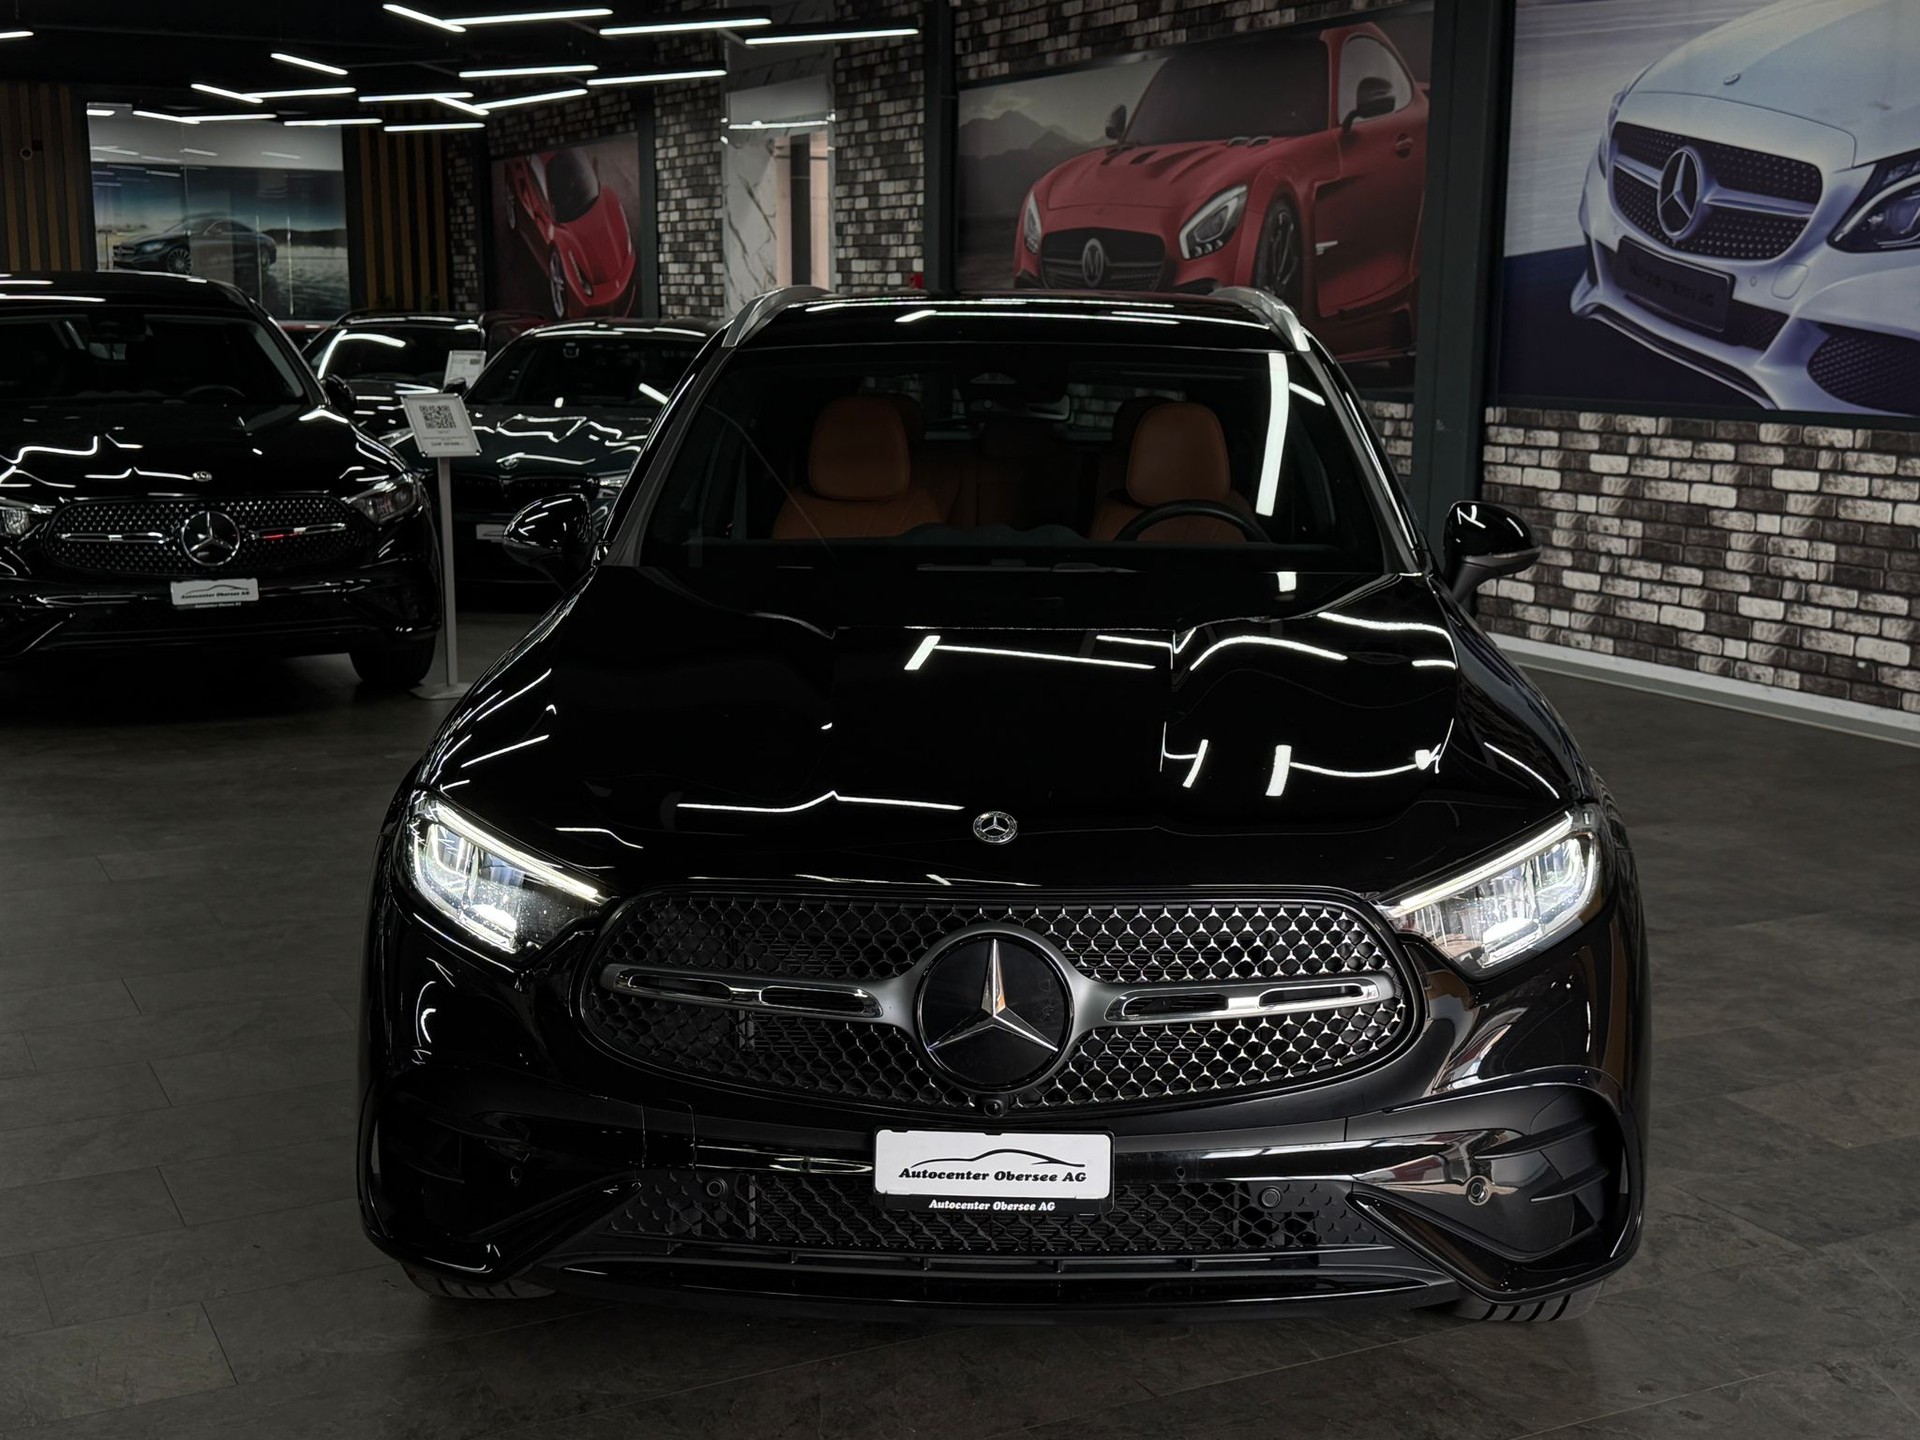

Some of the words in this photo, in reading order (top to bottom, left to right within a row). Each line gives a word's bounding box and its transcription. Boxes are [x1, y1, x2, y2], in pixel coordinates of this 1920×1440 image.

[899, 1168, 989, 1181] Autocenter
[994, 1171, 1058, 1182] Obersee
[1062, 1172, 1087, 1182] AG
[928, 1199, 990, 1211] Autocenter
[993, 1201, 1035, 1211] Obersee
[1038, 1202, 1056, 1211] AG
